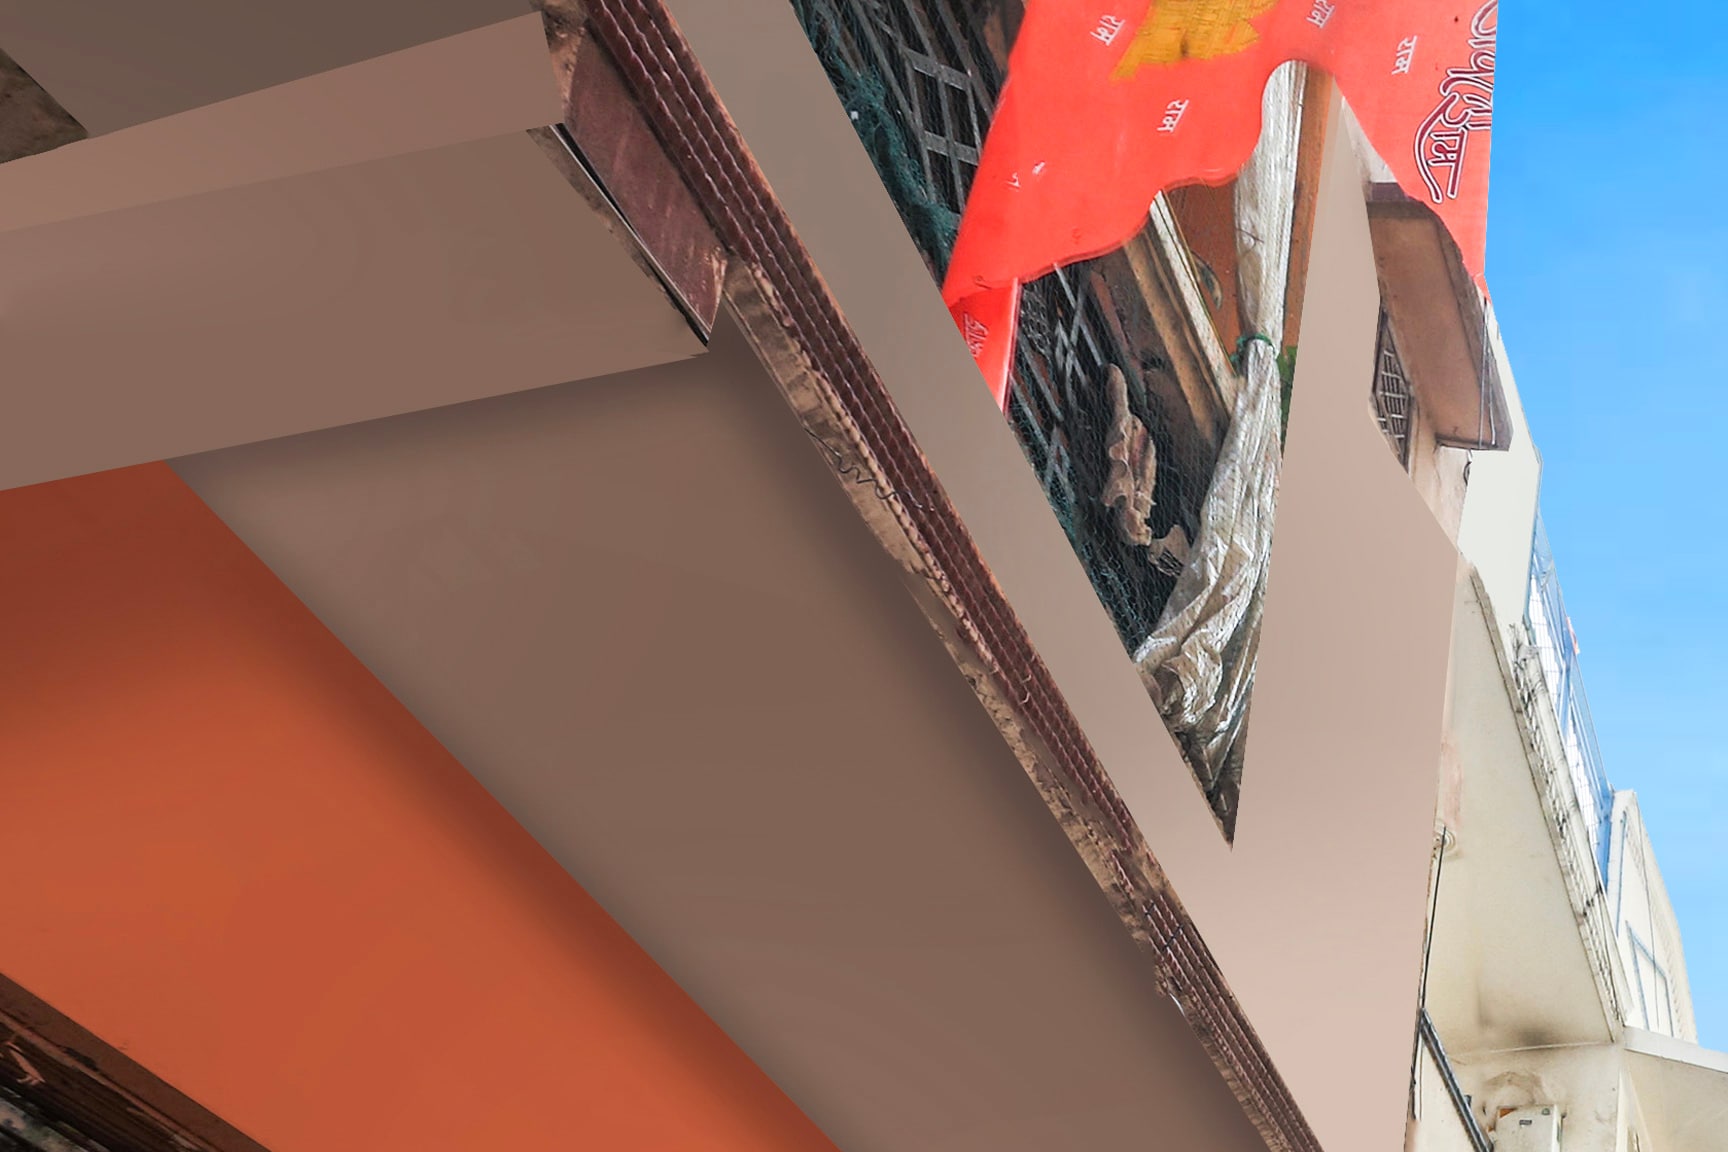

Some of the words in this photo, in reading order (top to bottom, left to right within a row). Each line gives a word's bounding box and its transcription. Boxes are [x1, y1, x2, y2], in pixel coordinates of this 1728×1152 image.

[1090, 14, 1126, 46] राम
[1391, 35, 1417, 75] राम
[1156, 99, 1189, 133] राम
